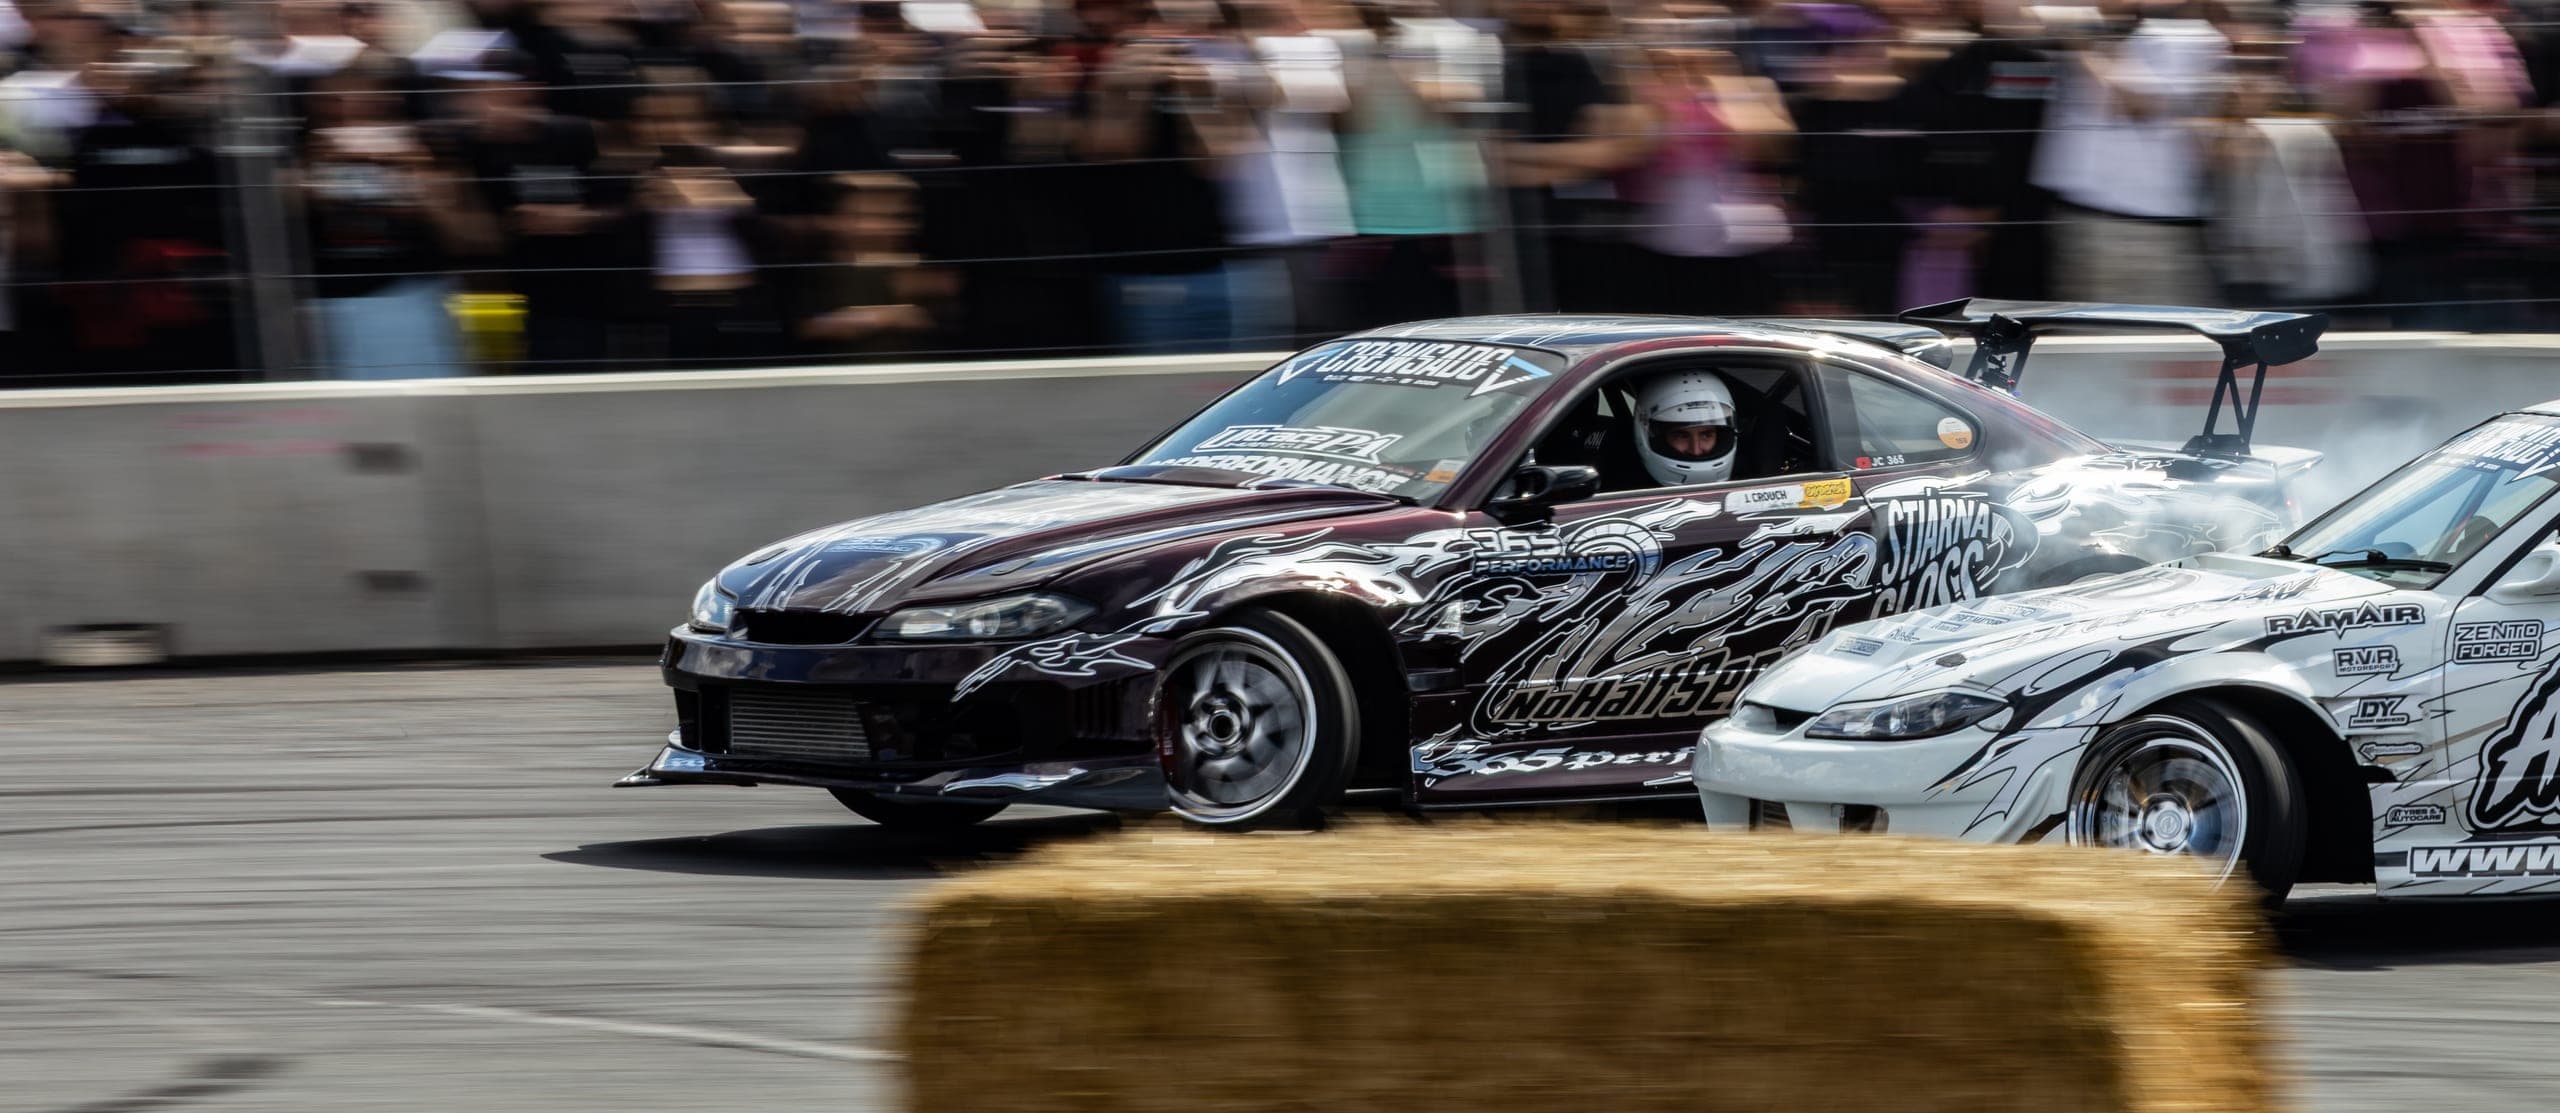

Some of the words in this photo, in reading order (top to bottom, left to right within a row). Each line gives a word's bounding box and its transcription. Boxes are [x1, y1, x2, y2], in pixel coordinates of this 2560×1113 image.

[1316, 340, 1514, 380] CREWSADE
[1871, 457, 1885, 467] JC
[1887, 454, 1905, 466] 365
[1751, 489, 1788, 503] CROUCH
[1467, 526, 1563, 558] 365
[1474, 554, 1629, 574] PERFORMANCE
[2268, 604, 2424, 637] RAMAIR
[2459, 641, 2535, 658] FORGED
[2361, 701, 2398, 718] DY
